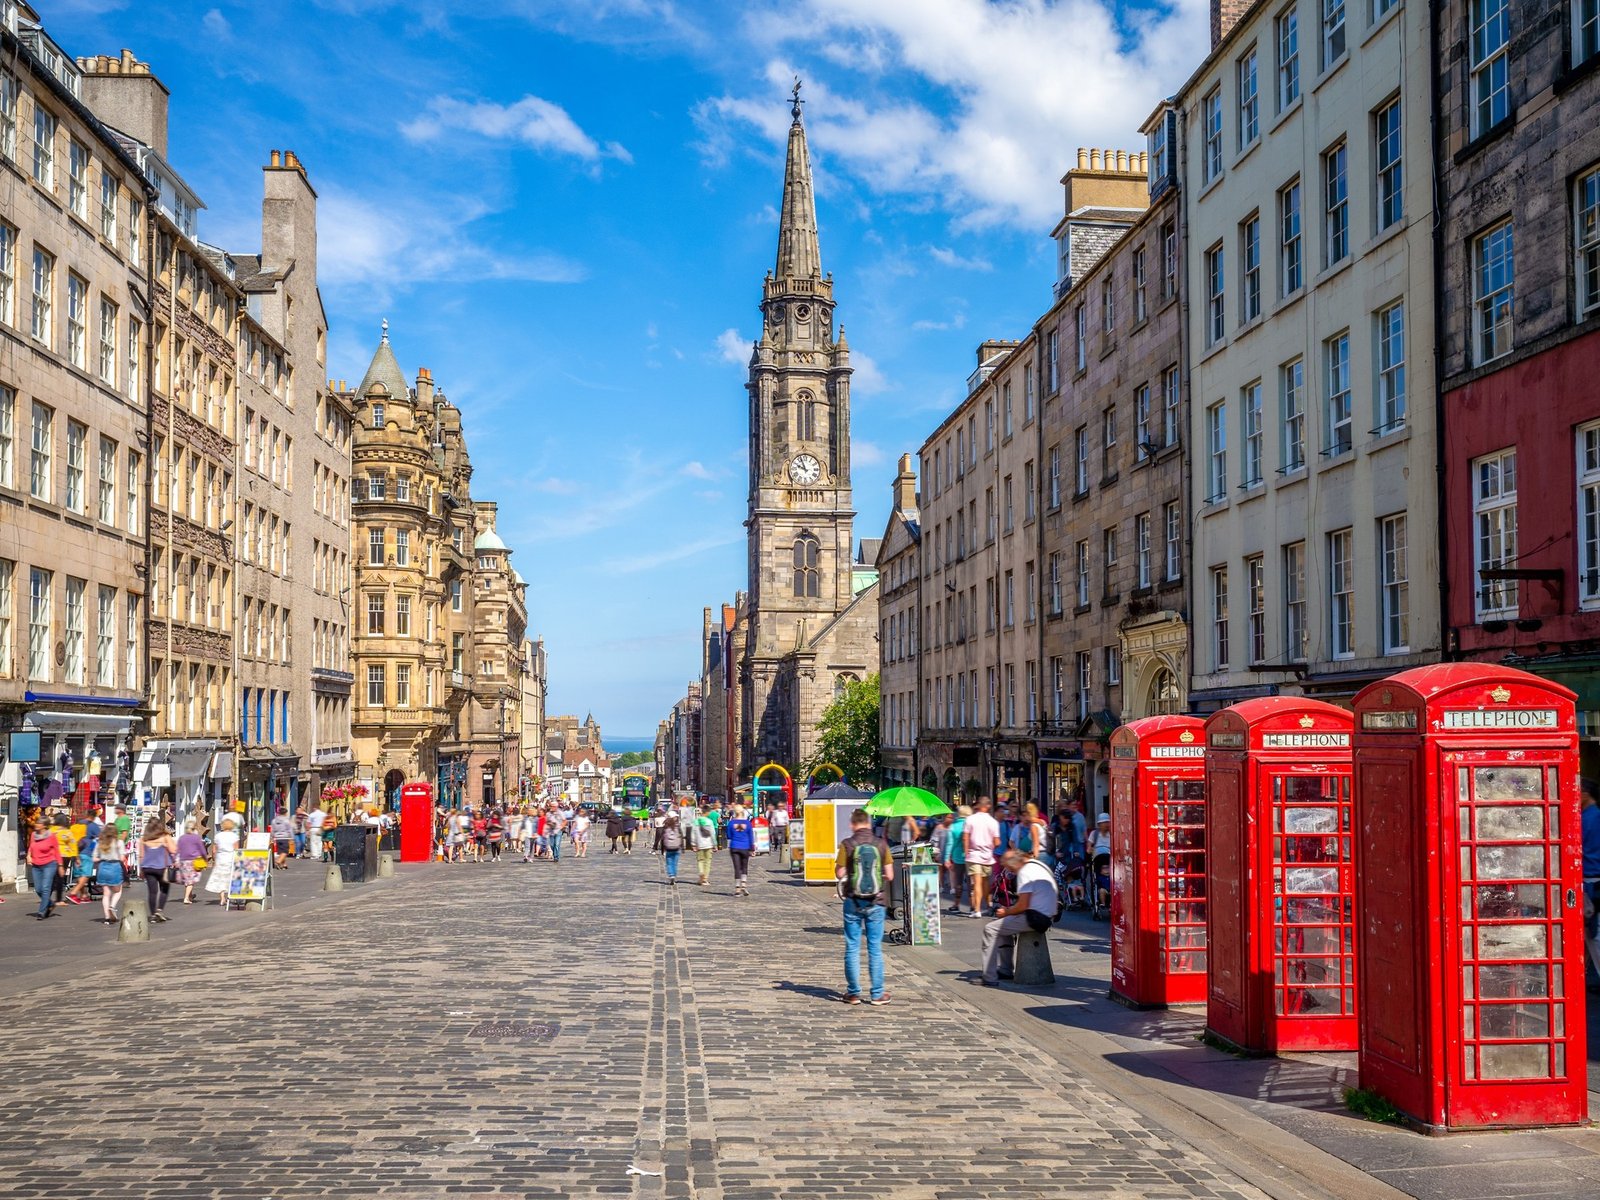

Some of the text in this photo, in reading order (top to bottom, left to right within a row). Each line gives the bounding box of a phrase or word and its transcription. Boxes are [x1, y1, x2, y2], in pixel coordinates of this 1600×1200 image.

[1448, 711, 1553, 727] TELEPHONE
[1266, 734, 1346, 746] TELEPHONE
[1153, 747, 1204, 757] TELEPHO
